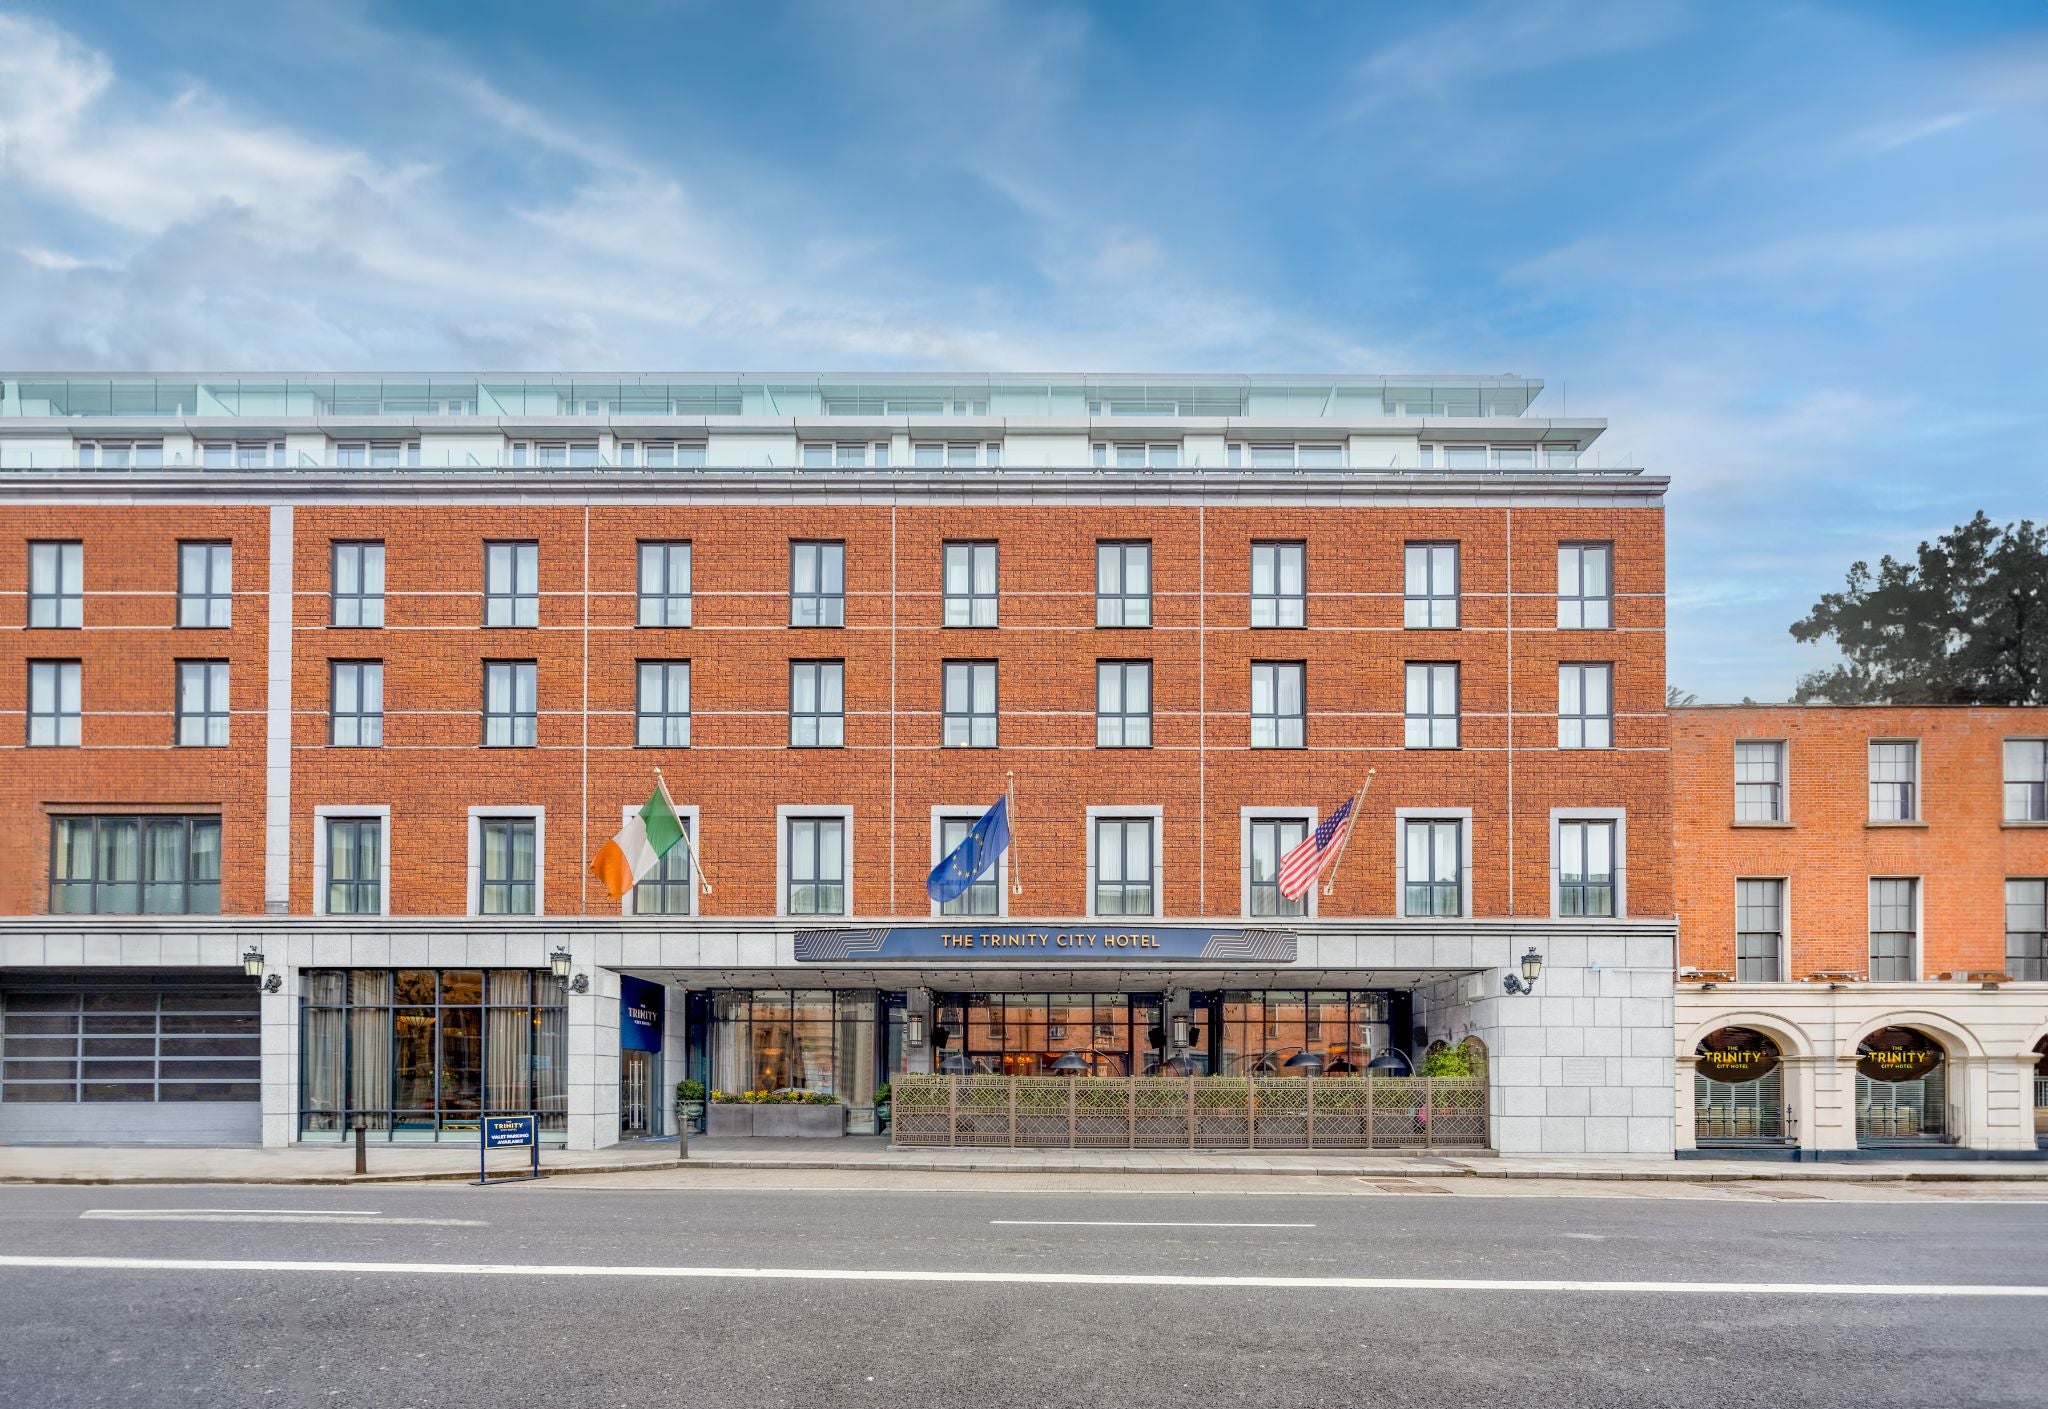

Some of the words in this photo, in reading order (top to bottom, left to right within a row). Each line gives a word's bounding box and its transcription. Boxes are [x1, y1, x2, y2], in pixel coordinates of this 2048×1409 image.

[941, 934, 974, 947] THE
[980, 934, 1049, 947] TRINITY
[1056, 934, 1097, 947] CITY
[1104, 934, 1160, 947] HOTEL
[627, 1007, 658, 1022] TRINITY
[1704, 1052, 1761, 1062] TRINITY
[1868, 1052, 1926, 1062] TRINITY
